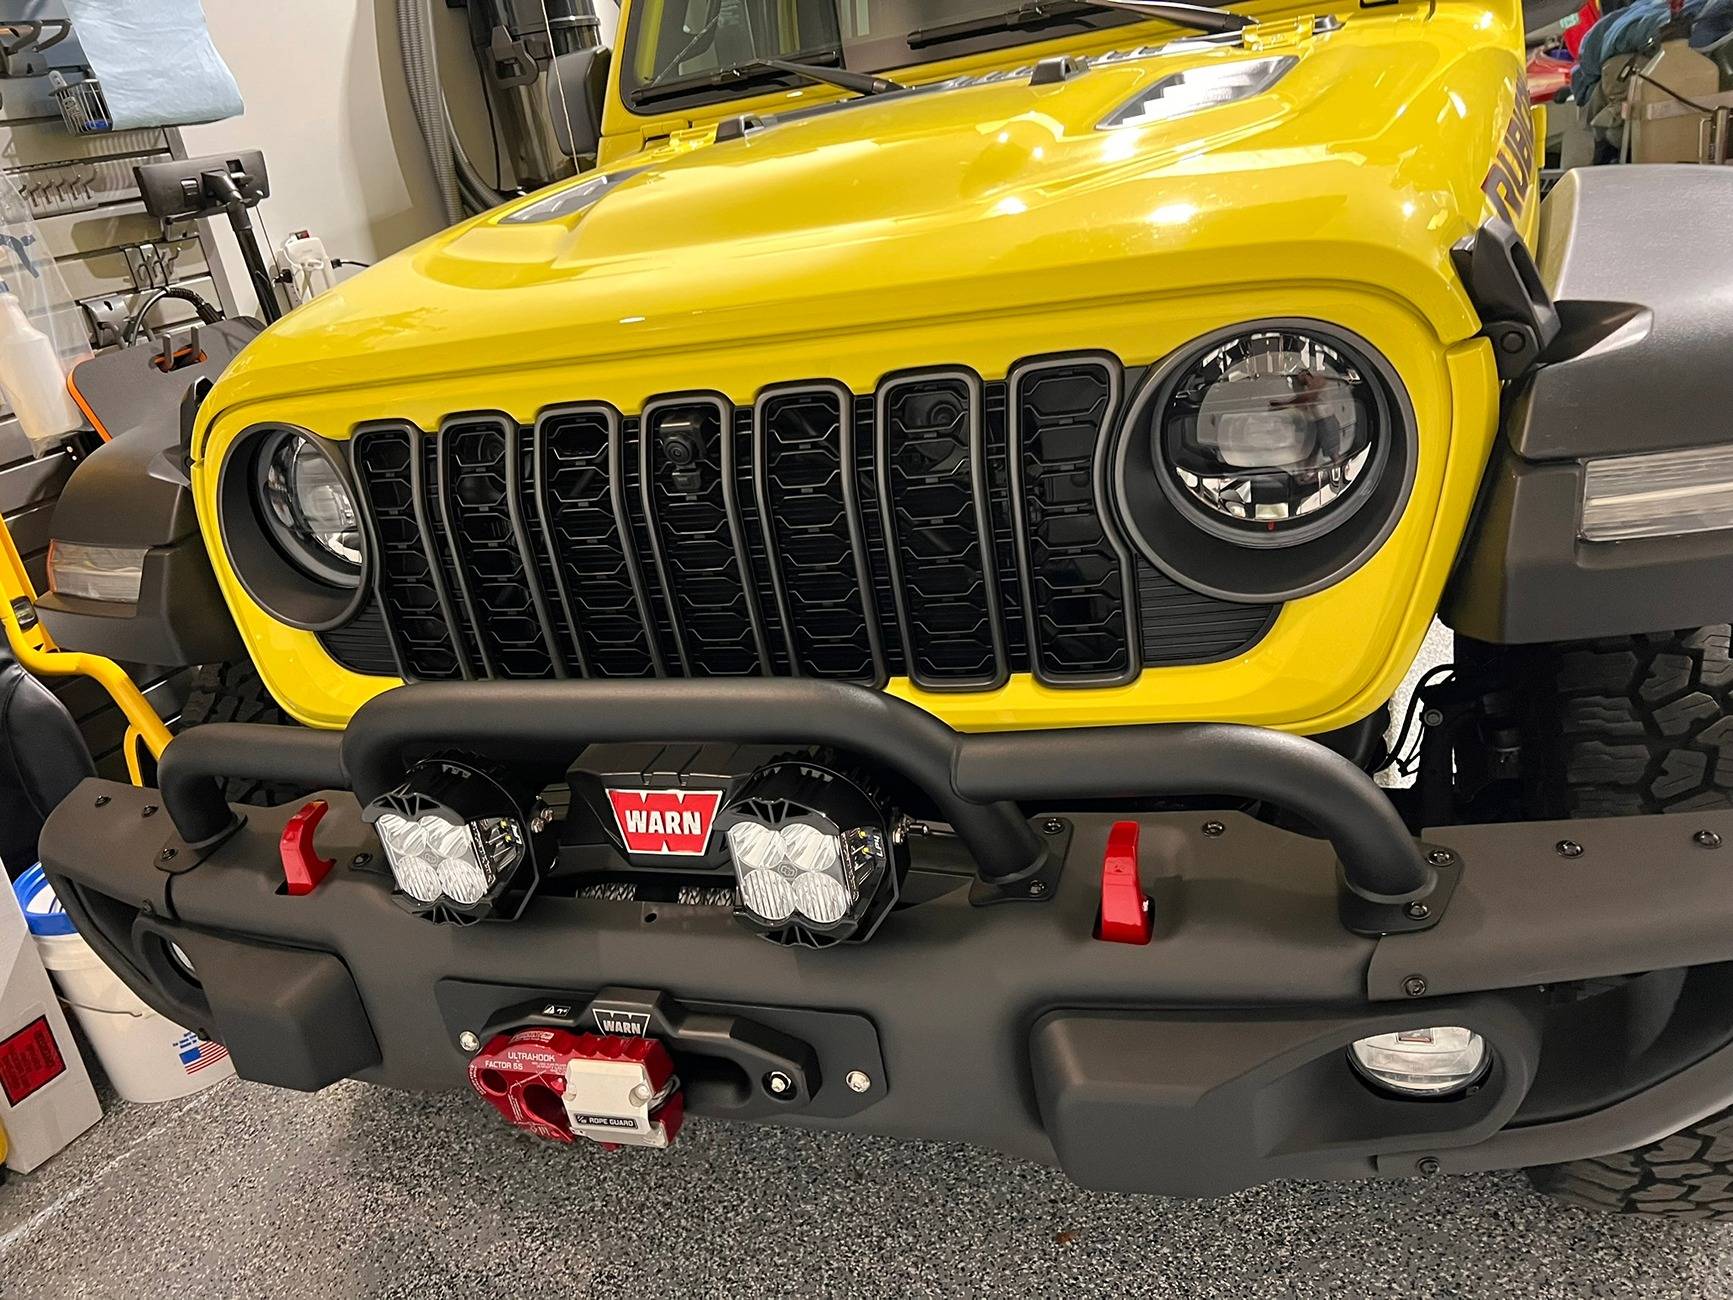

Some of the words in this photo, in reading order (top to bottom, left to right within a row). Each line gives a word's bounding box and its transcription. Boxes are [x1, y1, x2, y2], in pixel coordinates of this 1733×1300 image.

[625, 810, 702, 835] WARN
[603, 1019, 641, 1035] WARN
[508, 1051, 556, 1062] ULTRAHOOK
[485, 1060, 512, 1069] FACTOR
[589, 1117, 609, 1125] ROPE
[609, 1118, 634, 1127] GUARD
